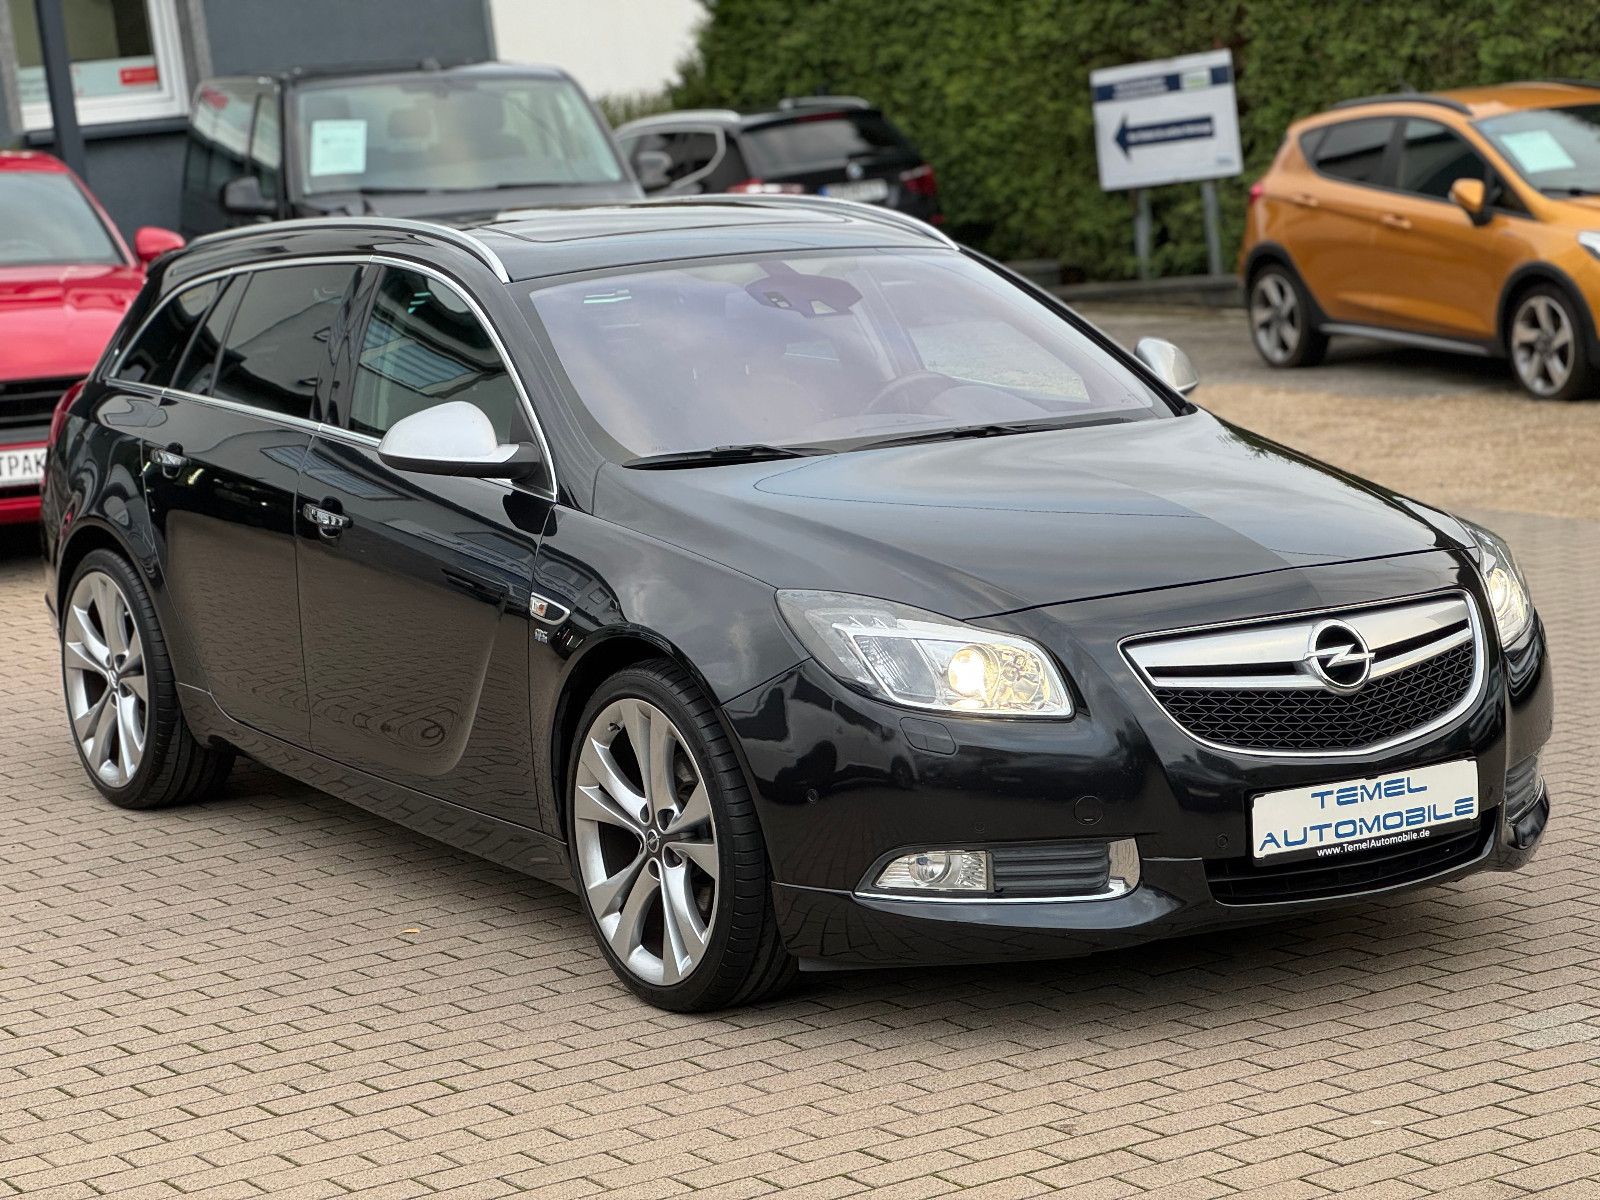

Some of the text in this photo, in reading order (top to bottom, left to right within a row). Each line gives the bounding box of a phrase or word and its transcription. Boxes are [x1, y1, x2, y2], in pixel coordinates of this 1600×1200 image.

[1310, 776, 1428, 809] TEMEL
[1258, 796, 1474, 852] AUTOMOBILE
[1316, 828, 1431, 857] www.TemelAutomobile.de
